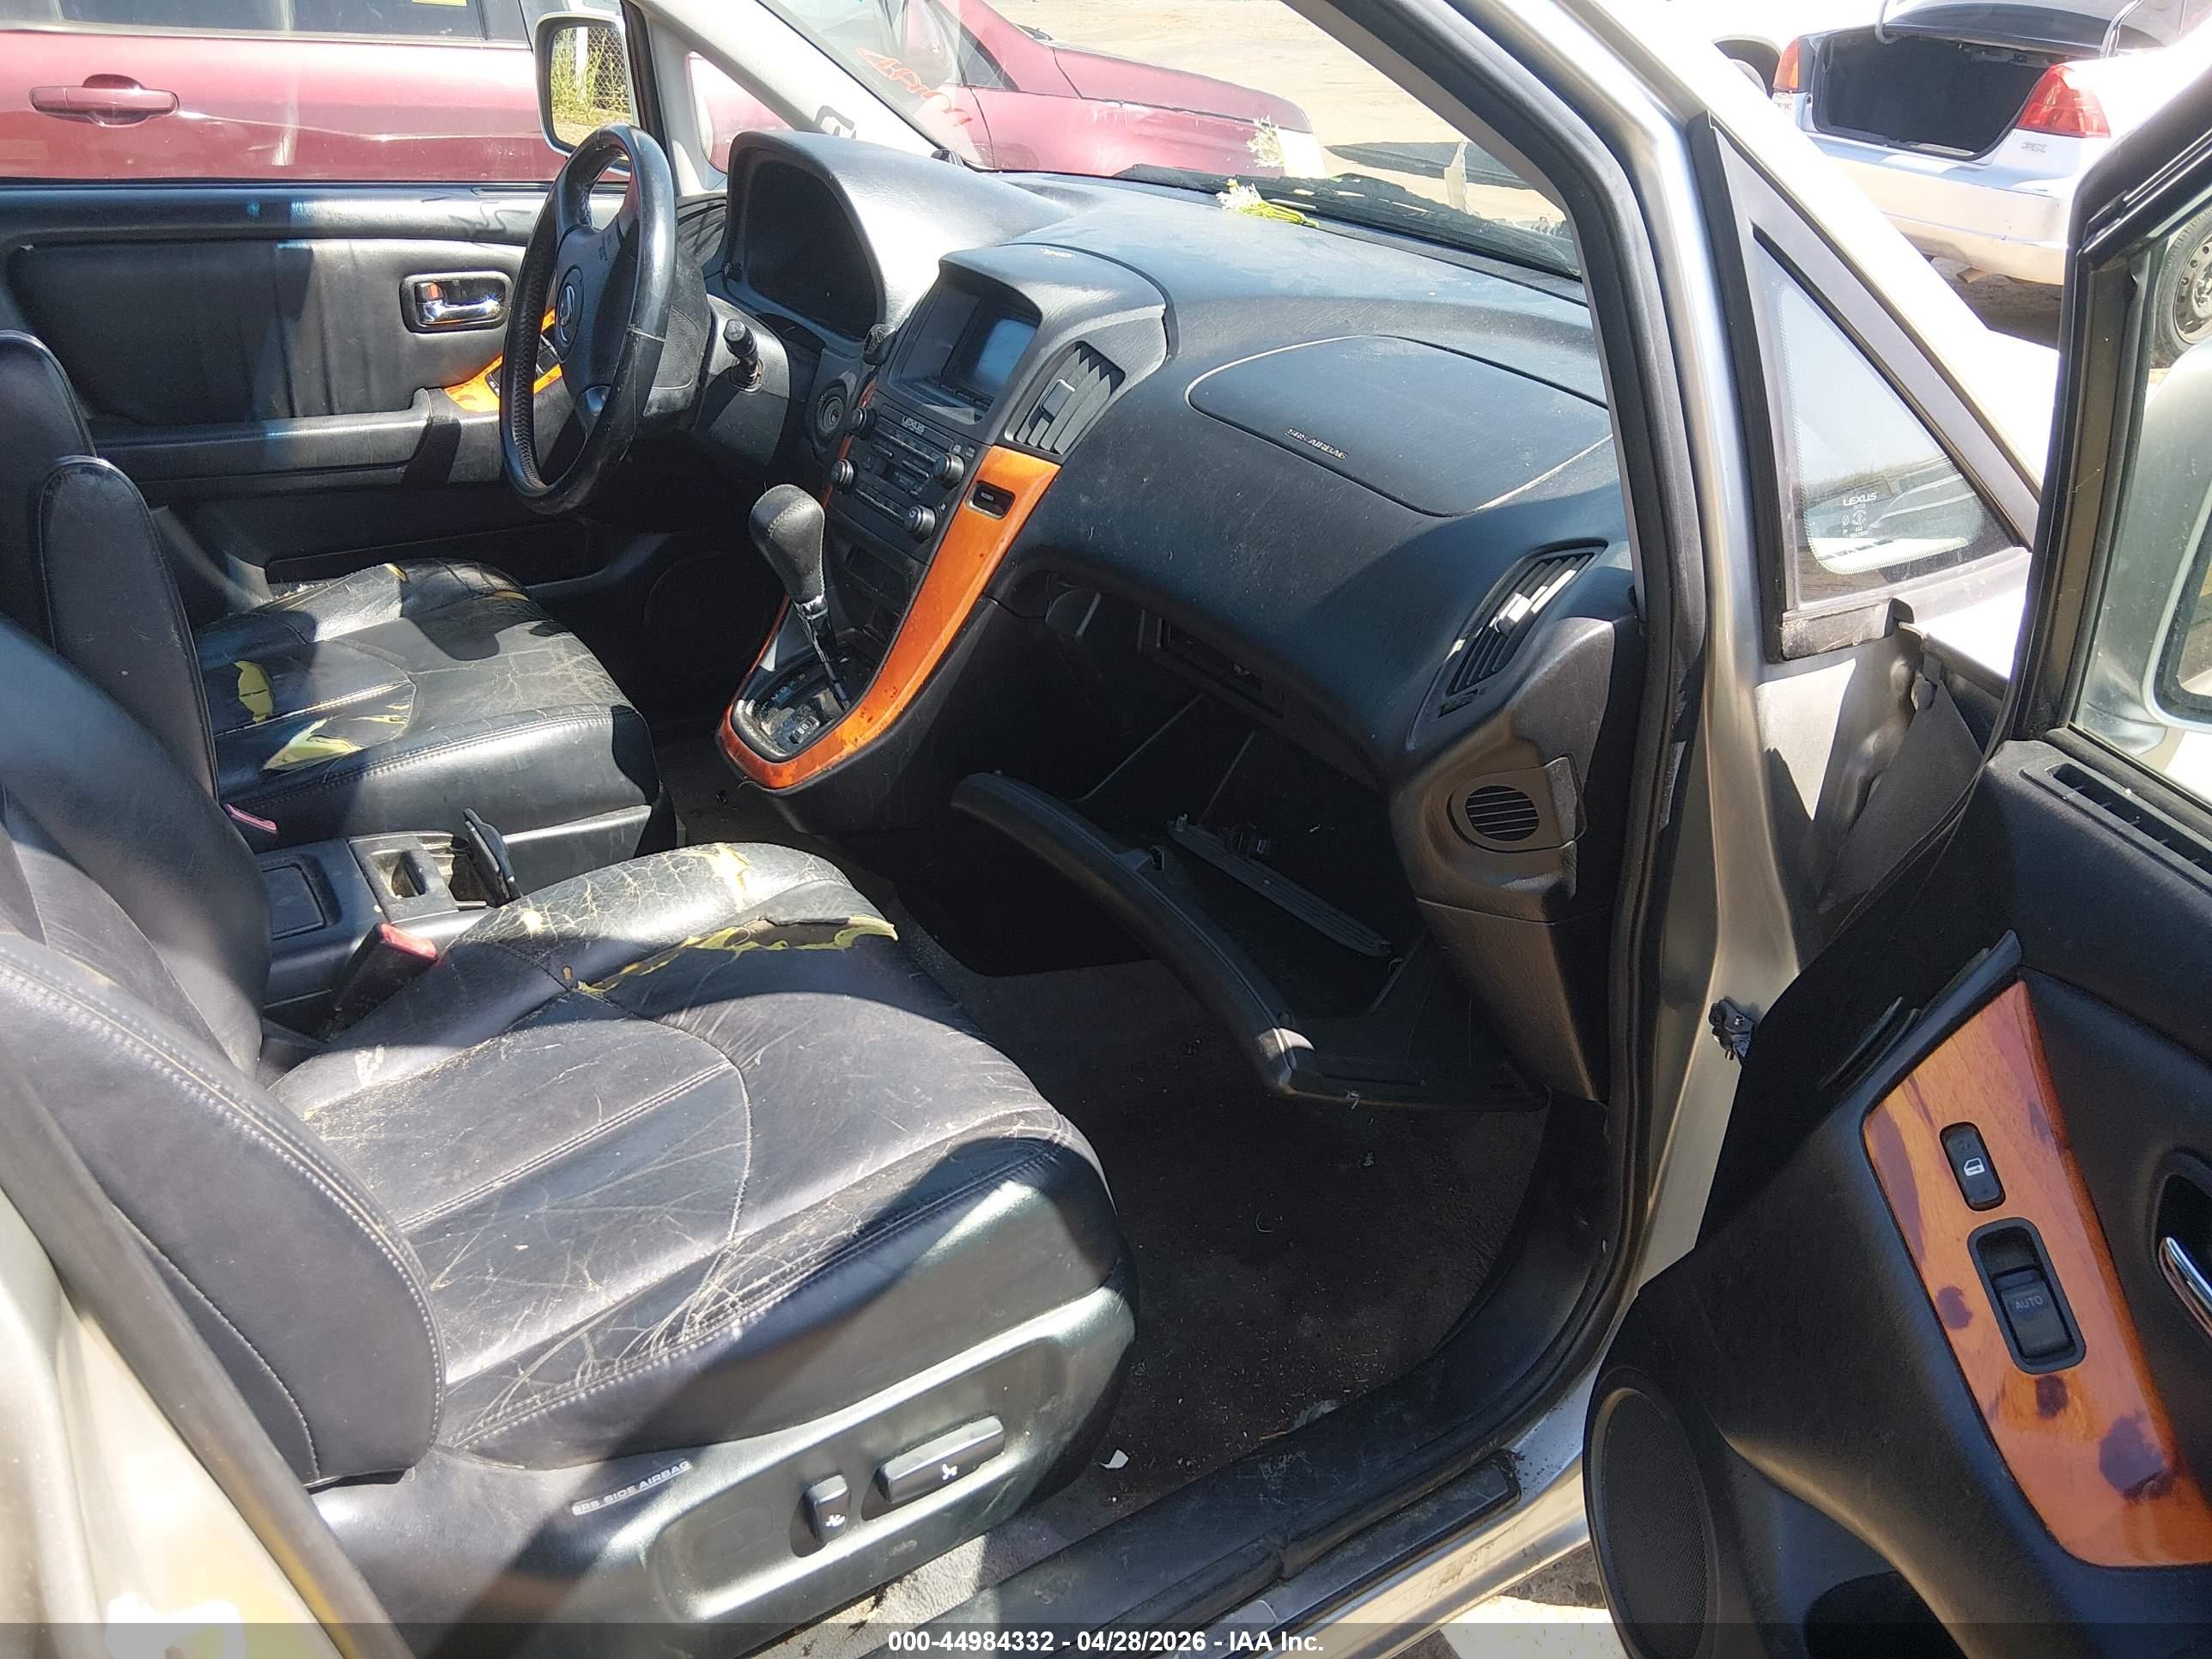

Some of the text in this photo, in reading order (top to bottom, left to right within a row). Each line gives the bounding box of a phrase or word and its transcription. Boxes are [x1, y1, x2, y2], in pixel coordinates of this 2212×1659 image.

[902, 416, 926, 433] LEXUS
[1287, 428, 1348, 459] SRS AIRBAG
[1843, 492, 1877, 507] LEXUS
[2015, 1295, 2044, 1310] AUTO
[572, 1460, 690, 1514] SRS SIDE AIRBAG
